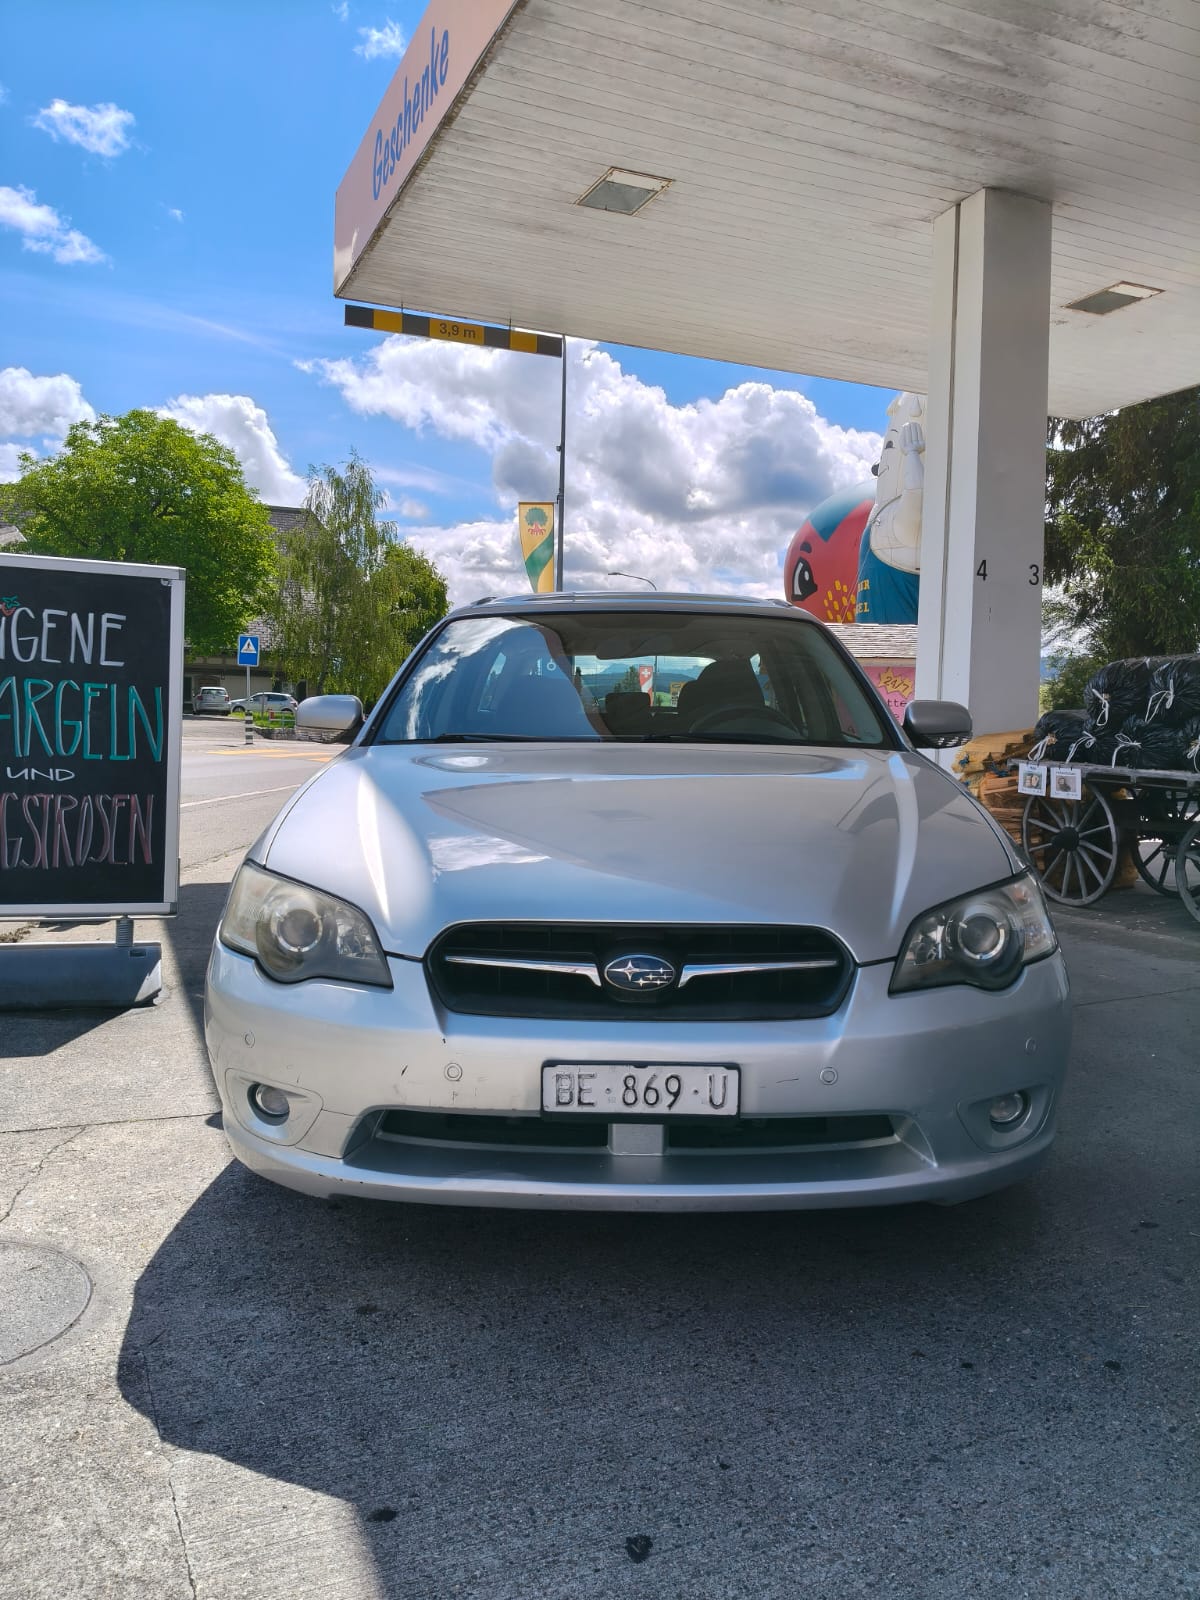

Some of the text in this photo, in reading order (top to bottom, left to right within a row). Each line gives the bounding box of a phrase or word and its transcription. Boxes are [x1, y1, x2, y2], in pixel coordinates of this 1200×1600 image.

[372, 26, 449, 200] Geschenke
[439, 322, 476, 339] 3,9 m
[976, 559, 988, 581] 4
[1028, 564, 1040, 586] 3
[883, 676, 910, 693] 24/7
[0, 676, 164, 763] ARGELN
[6, 766, 76, 782] UND
[555, 1072, 727, 1110] BE 869 U
